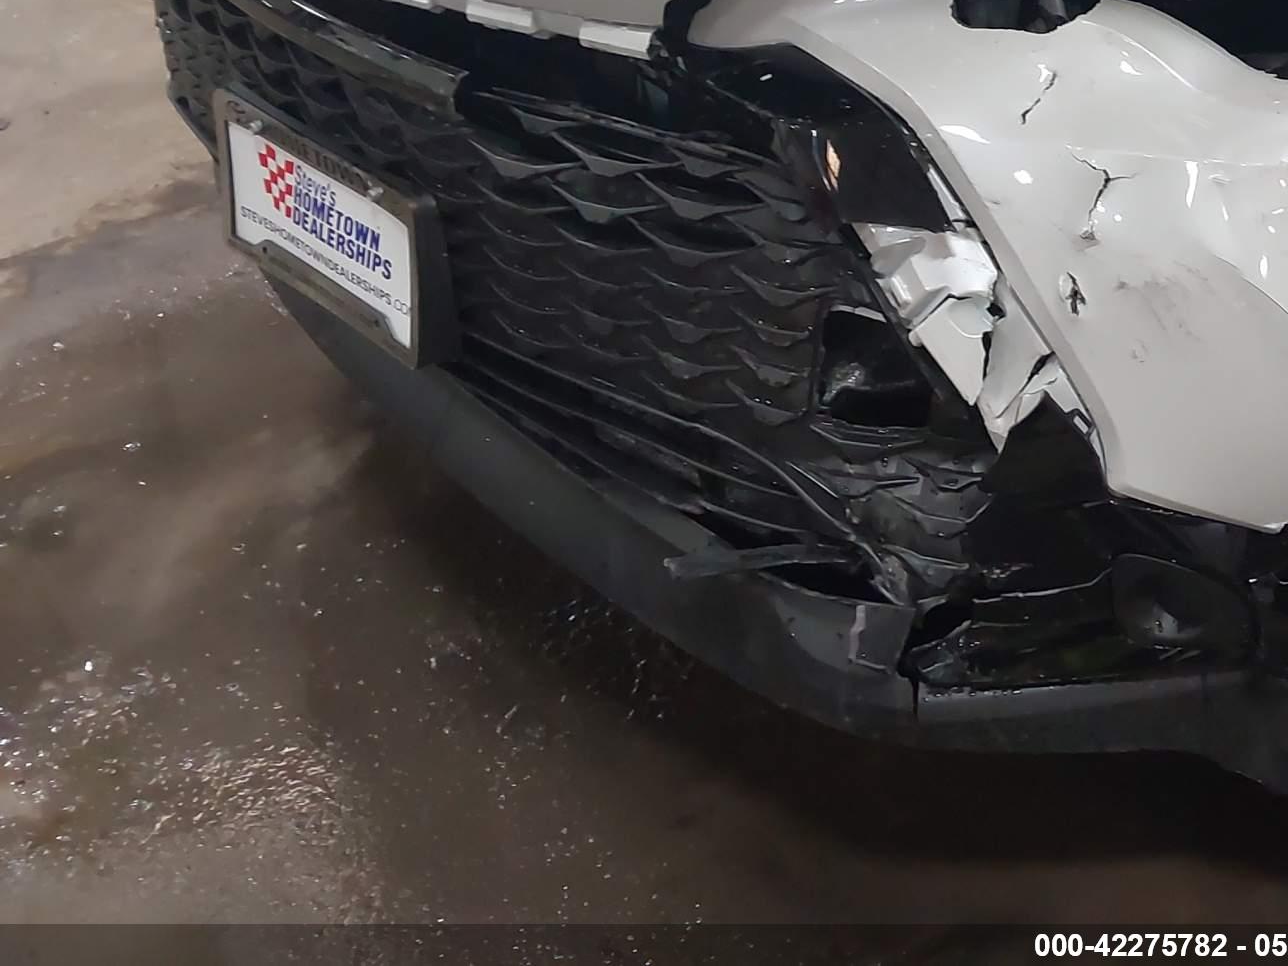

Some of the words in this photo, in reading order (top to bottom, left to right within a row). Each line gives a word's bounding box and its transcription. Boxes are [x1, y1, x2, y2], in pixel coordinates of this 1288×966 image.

[294, 164, 337, 207] Steve's
[294, 187, 381, 252] HOMETOWN
[239, 205, 409, 316] STEVESHOMETOWNDEALERSHIPS.CO
[292, 205, 393, 281] DEALERSHIPS
